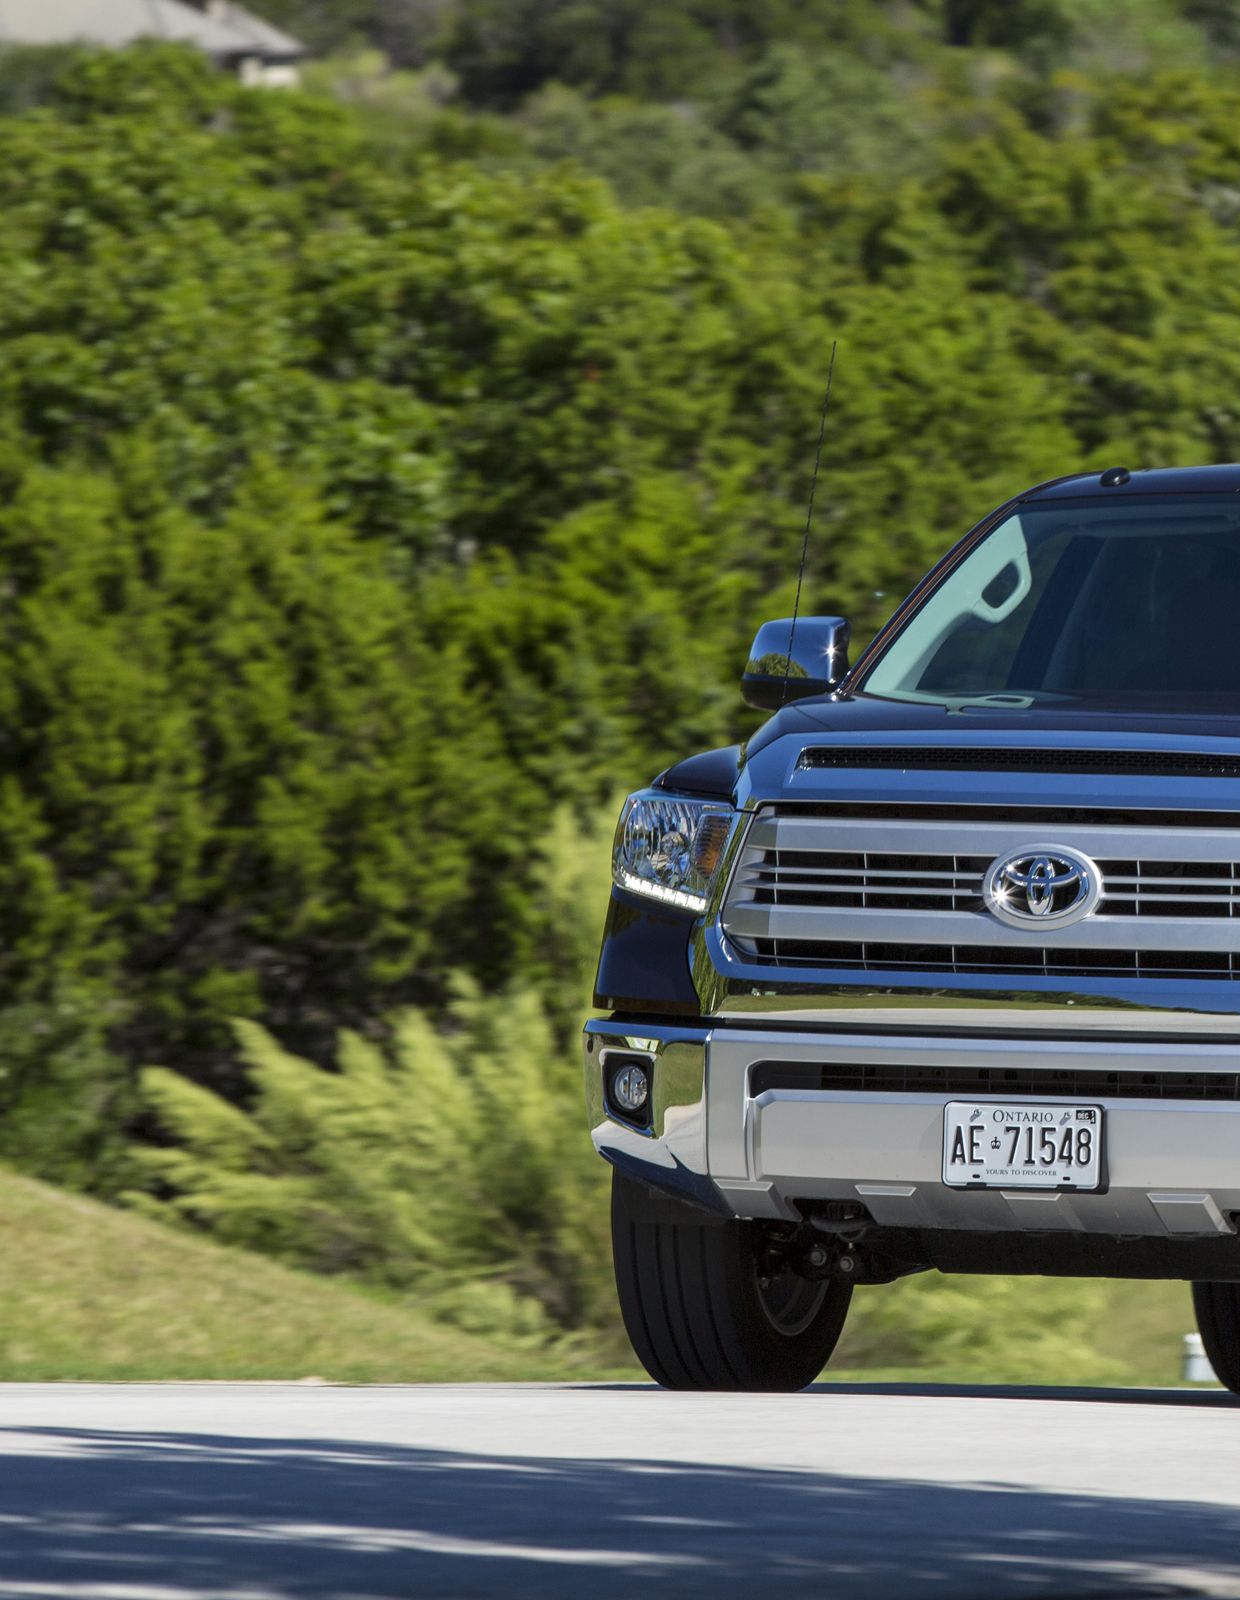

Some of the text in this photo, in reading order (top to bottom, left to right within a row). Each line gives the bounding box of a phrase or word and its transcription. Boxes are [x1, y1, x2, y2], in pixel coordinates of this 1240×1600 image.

[992, 1110, 1053, 1123] ONTARIO
[1077, 1112, 1089, 1120] DEC
[951, 1125, 1092, 1166] AE 71548
[985, 1168, 1057, 1177] YOURS TO DISCOVER
